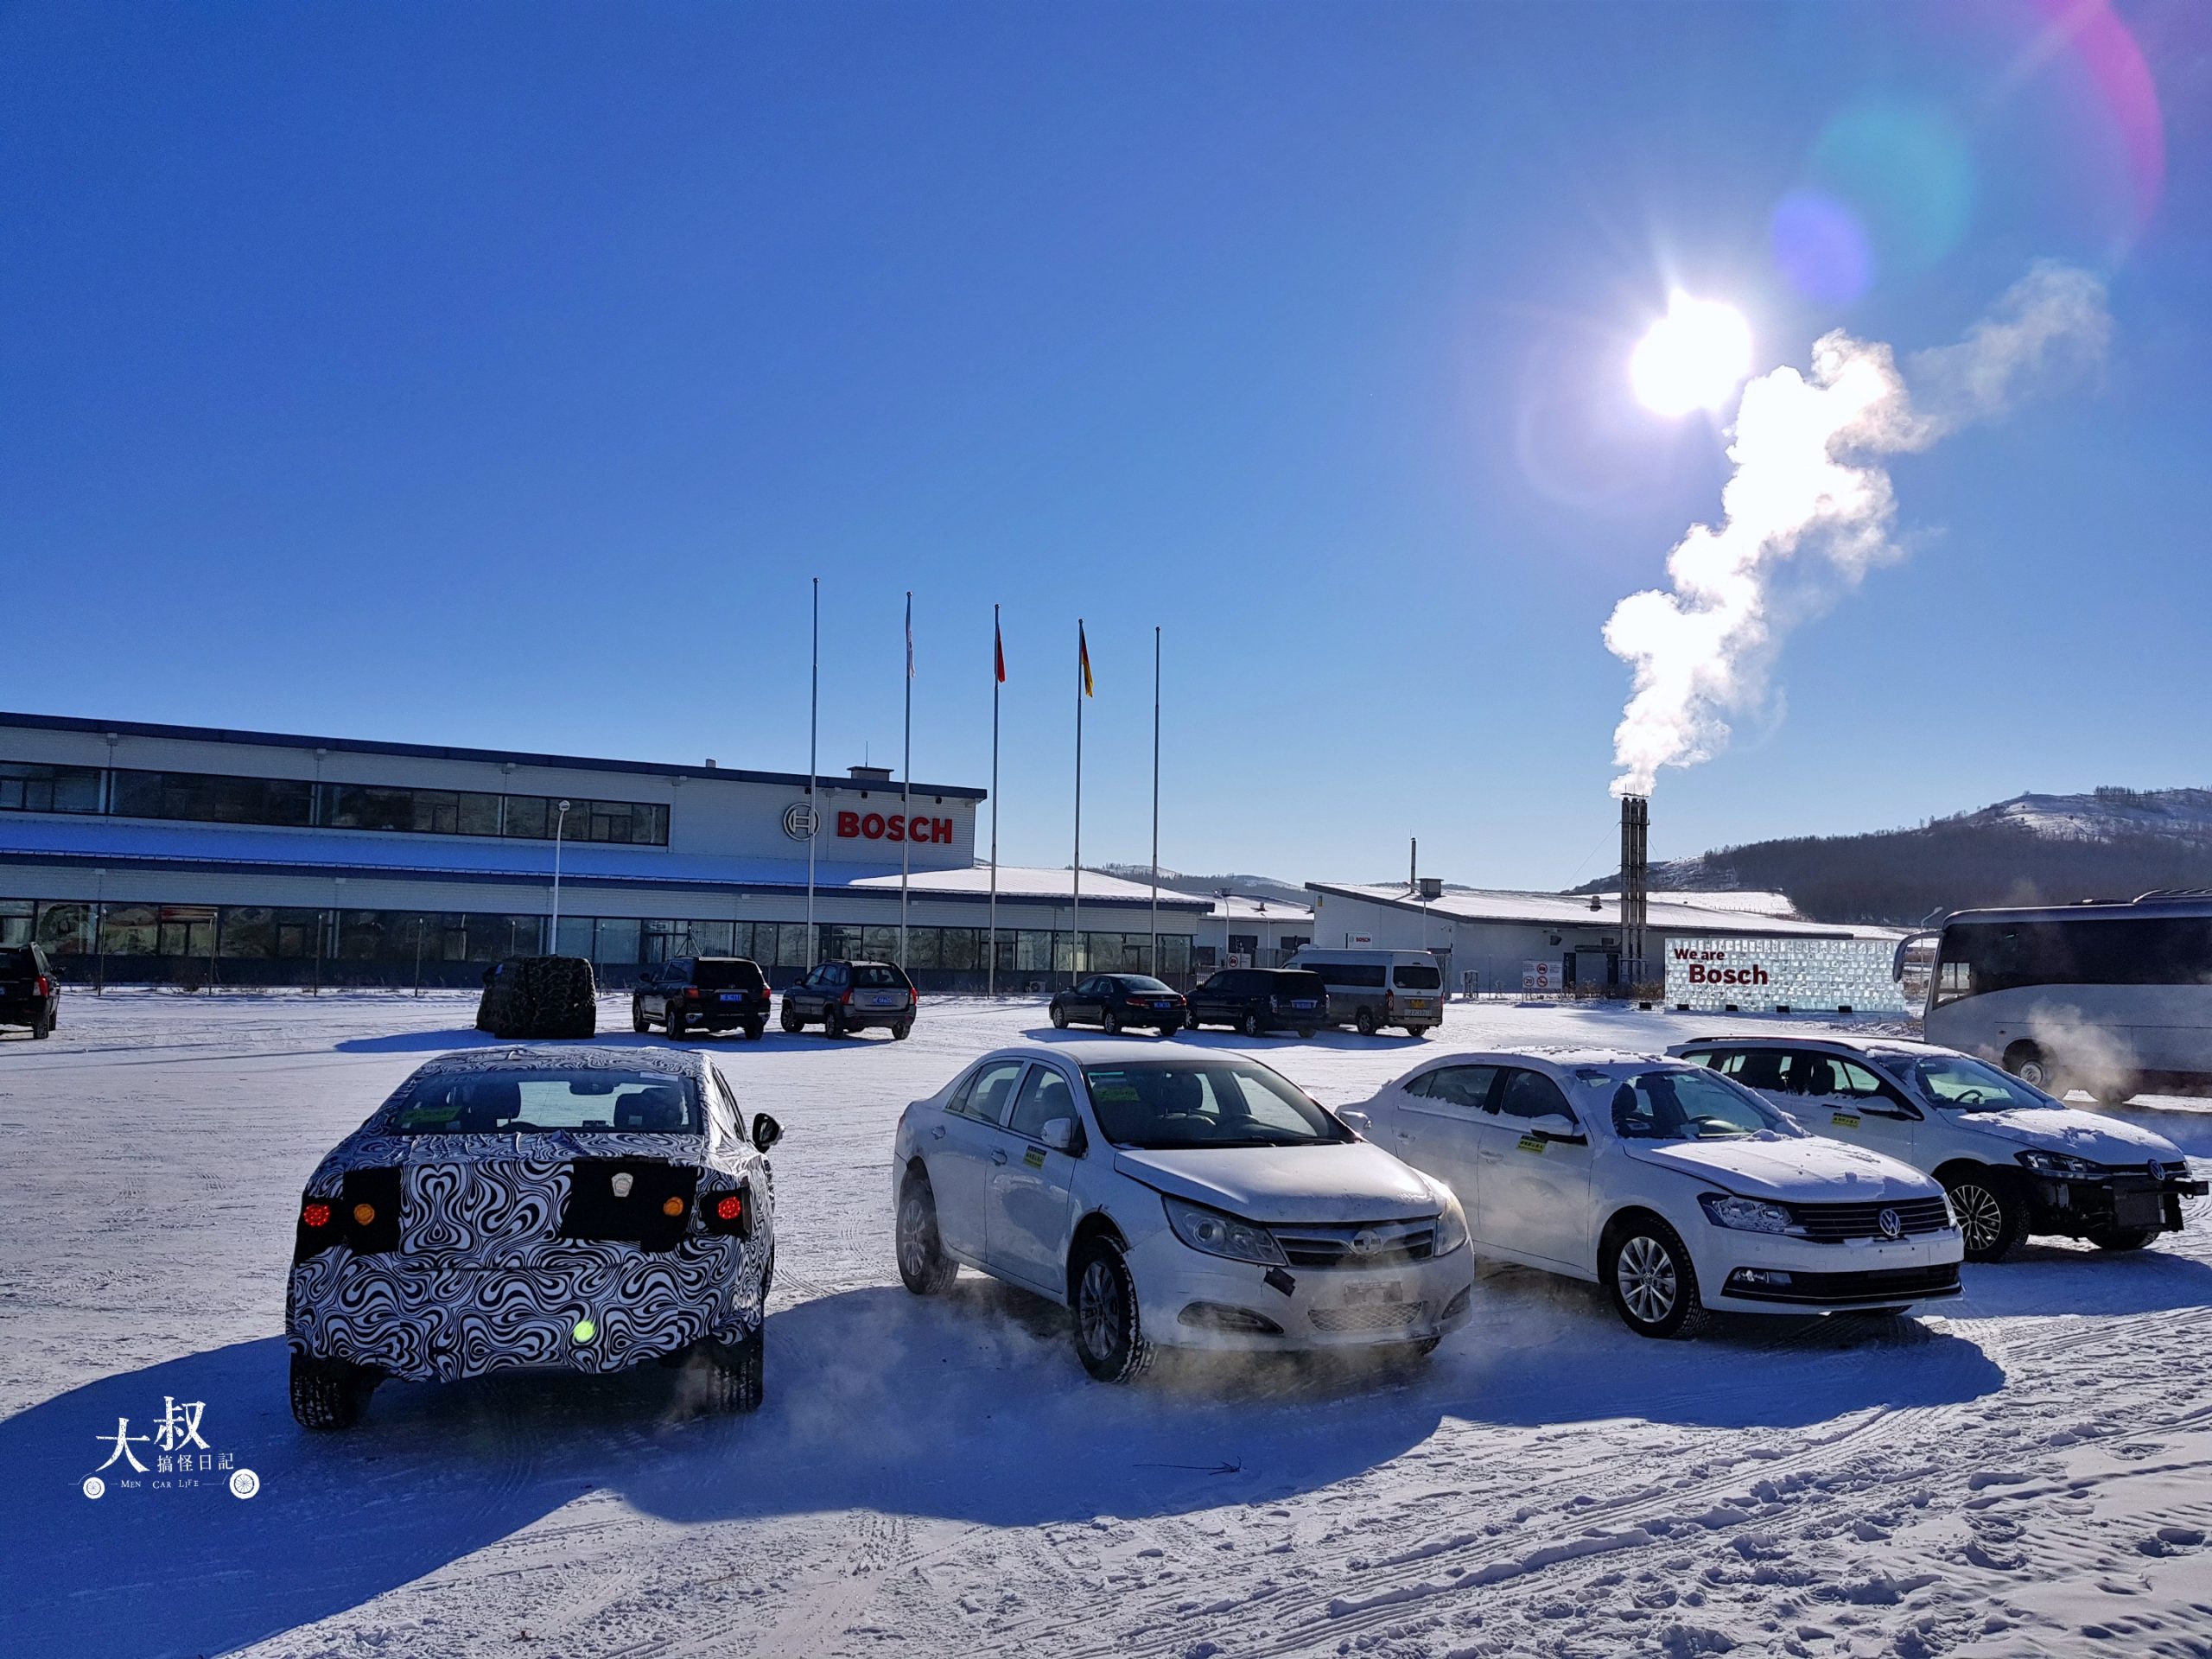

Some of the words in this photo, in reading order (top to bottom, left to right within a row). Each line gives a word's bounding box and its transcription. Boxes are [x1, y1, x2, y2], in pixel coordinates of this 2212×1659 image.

[837, 811, 952, 843] BOSCH
[1674, 948, 1698, 960] We
[1700, 951, 1725, 961] are
[1689, 963, 1768, 985] Bosch
